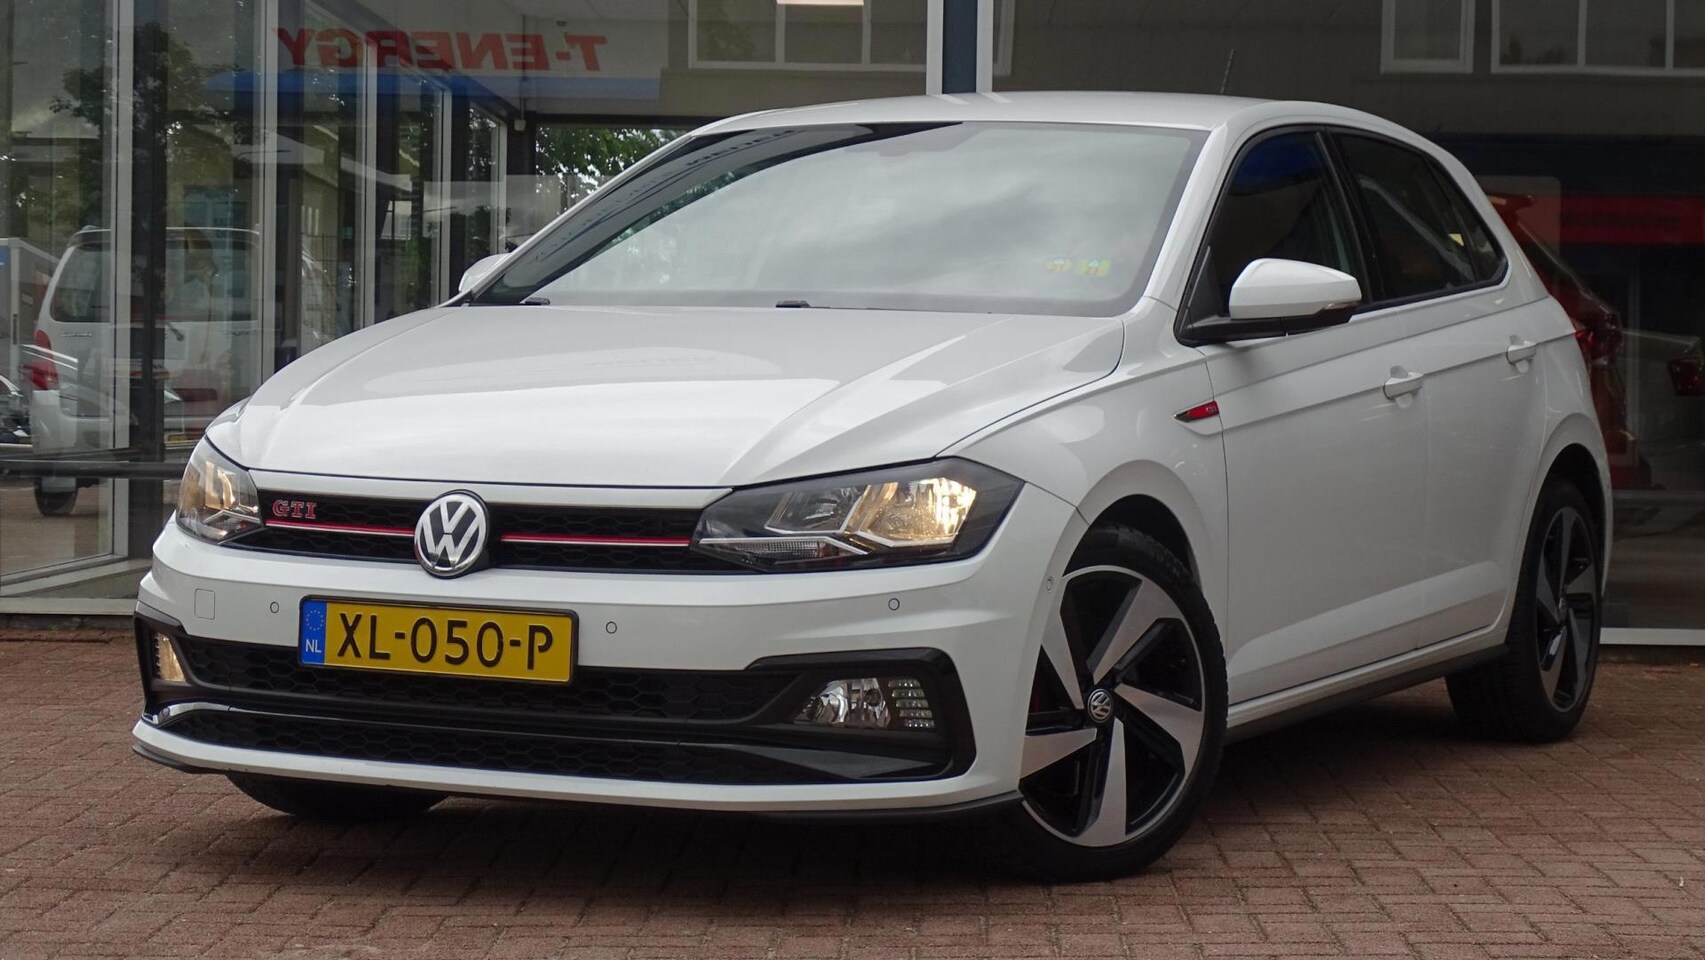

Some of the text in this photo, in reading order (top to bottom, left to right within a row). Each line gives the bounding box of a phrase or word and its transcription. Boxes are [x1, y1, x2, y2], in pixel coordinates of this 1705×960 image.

[272, 499, 317, 519] GTI
[305, 639, 322, 653] NL
[337, 612, 553, 670] XL-050-P
